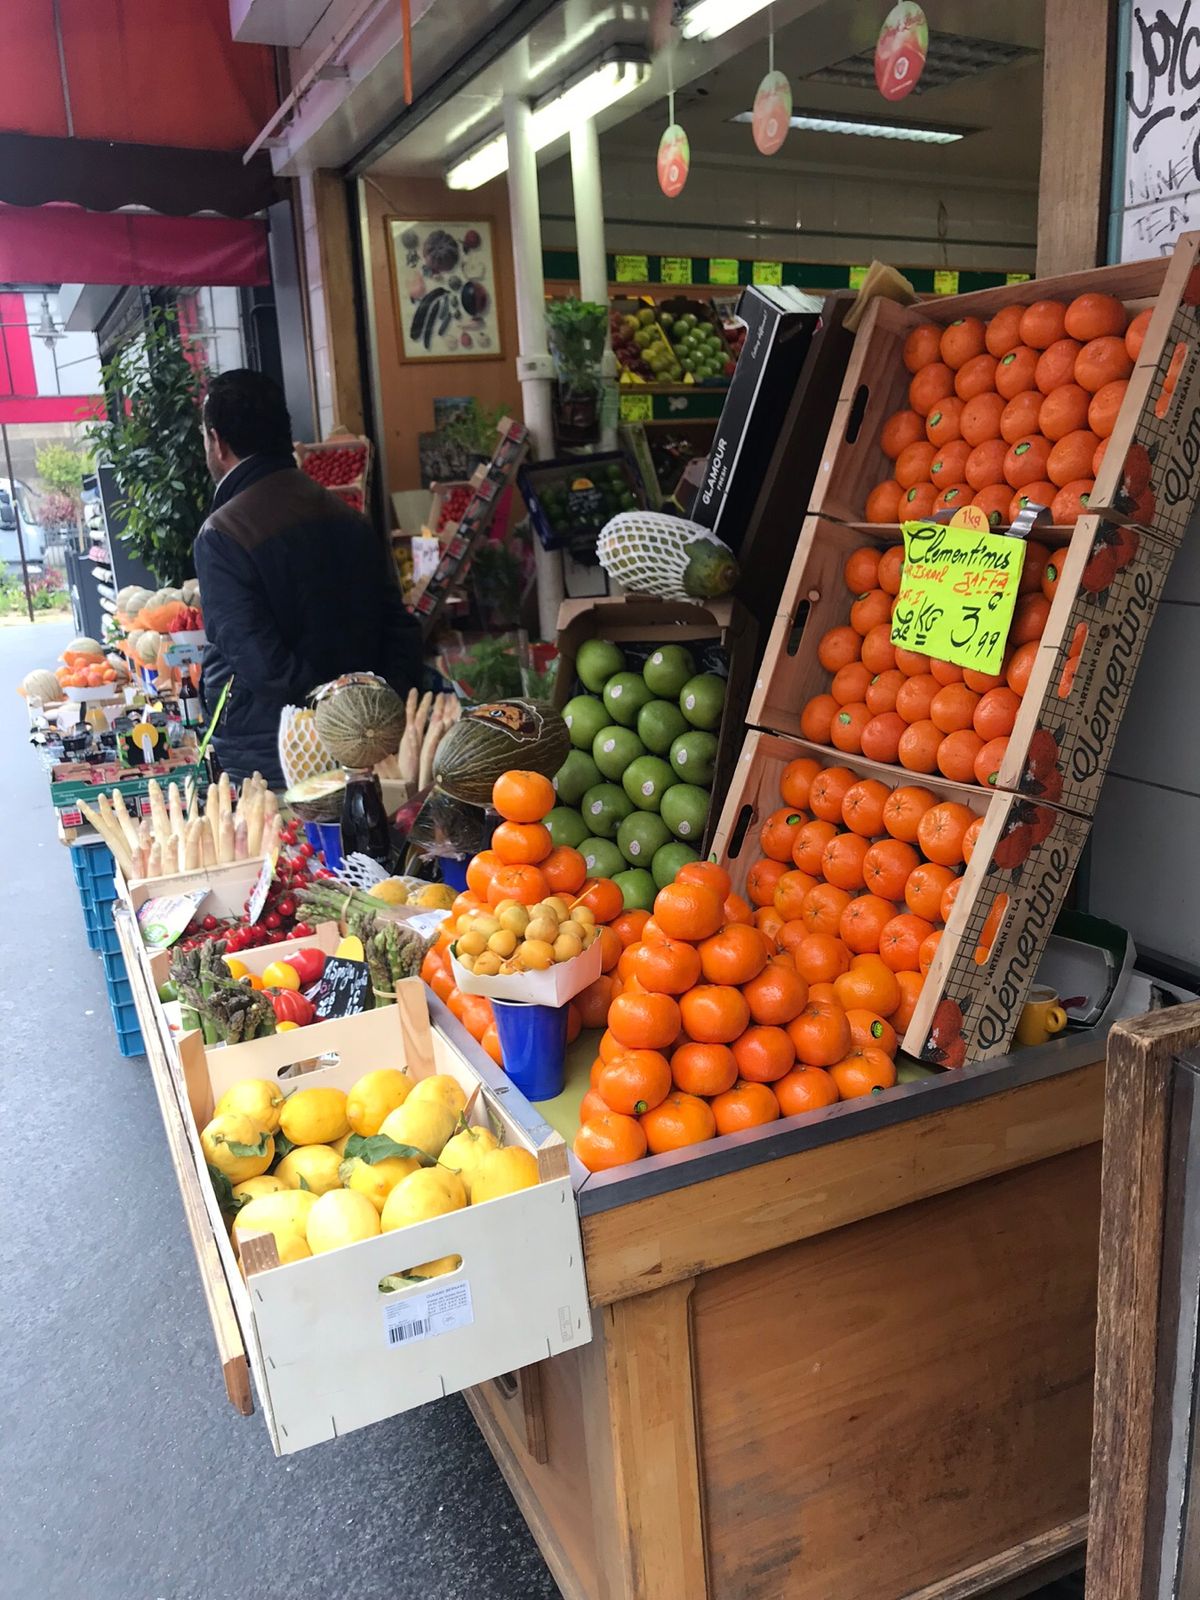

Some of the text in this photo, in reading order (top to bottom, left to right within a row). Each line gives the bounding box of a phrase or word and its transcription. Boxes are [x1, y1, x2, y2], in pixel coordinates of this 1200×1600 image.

[1169, 376, 1193, 435] L'ARTISAN
[1188, 356, 1199, 375] DE
[702, 438, 728, 505] GLAMOUR
[717, 465, 728, 491] FRESH
[953, 569, 1010, 595] JAFFA
[1072, 571, 1154, 783] Clémentine
[1076, 640, 1104, 716] L'ARTISAN DE
[976, 846, 1069, 1050] Clémentine
[984, 898, 1021, 986] L'ARTISAN DE LA
